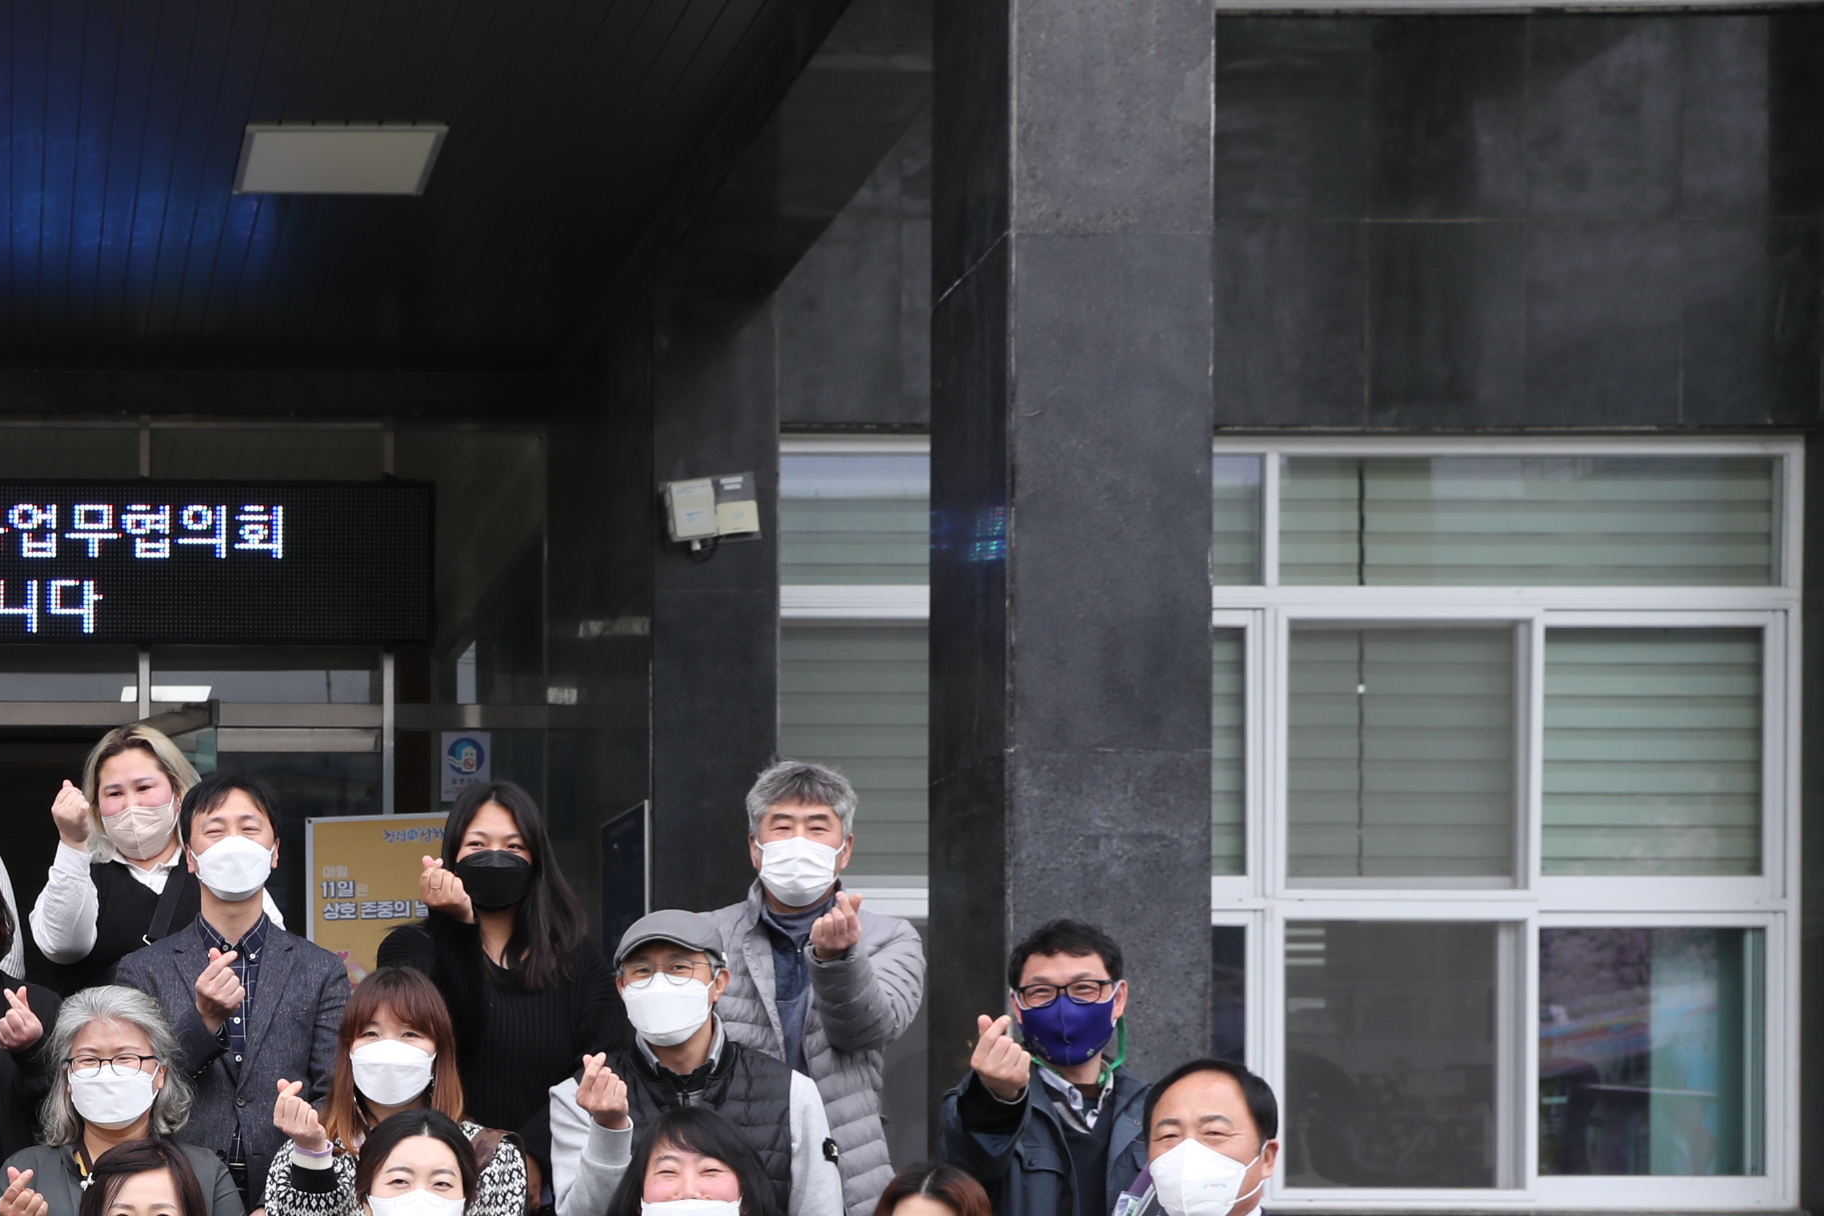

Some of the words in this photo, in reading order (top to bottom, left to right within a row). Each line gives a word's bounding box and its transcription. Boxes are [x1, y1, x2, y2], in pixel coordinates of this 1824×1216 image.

[323, 865, 348, 878] 매월
[323, 902, 357, 920] 상호
[361, 900, 411, 919] 존중의
